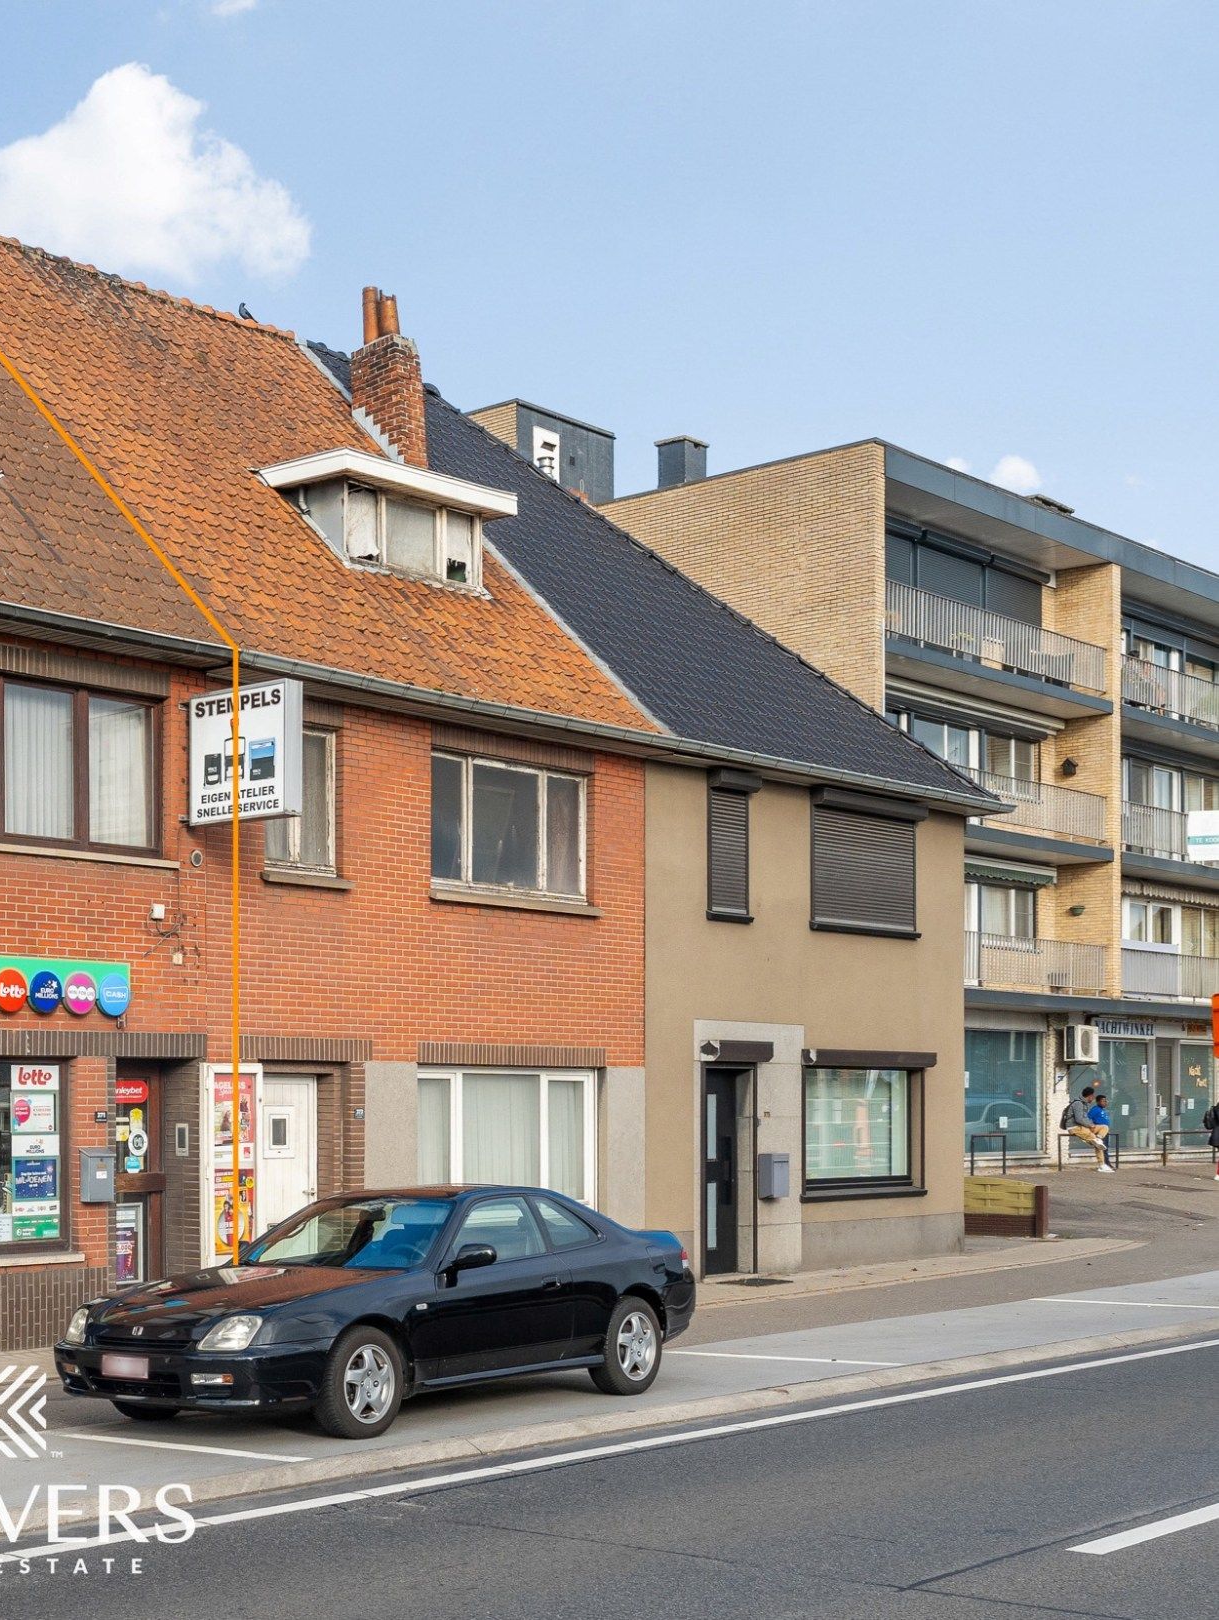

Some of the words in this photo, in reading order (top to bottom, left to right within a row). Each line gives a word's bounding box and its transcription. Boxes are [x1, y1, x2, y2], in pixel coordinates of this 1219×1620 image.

[201, 791, 231, 804] EIGEN
[237, 785, 275, 799] TELIER
[197, 804, 233, 818] SNELLE
[237, 798, 279, 813] SERVICE
[115, 1086, 143, 1095] nleybet
